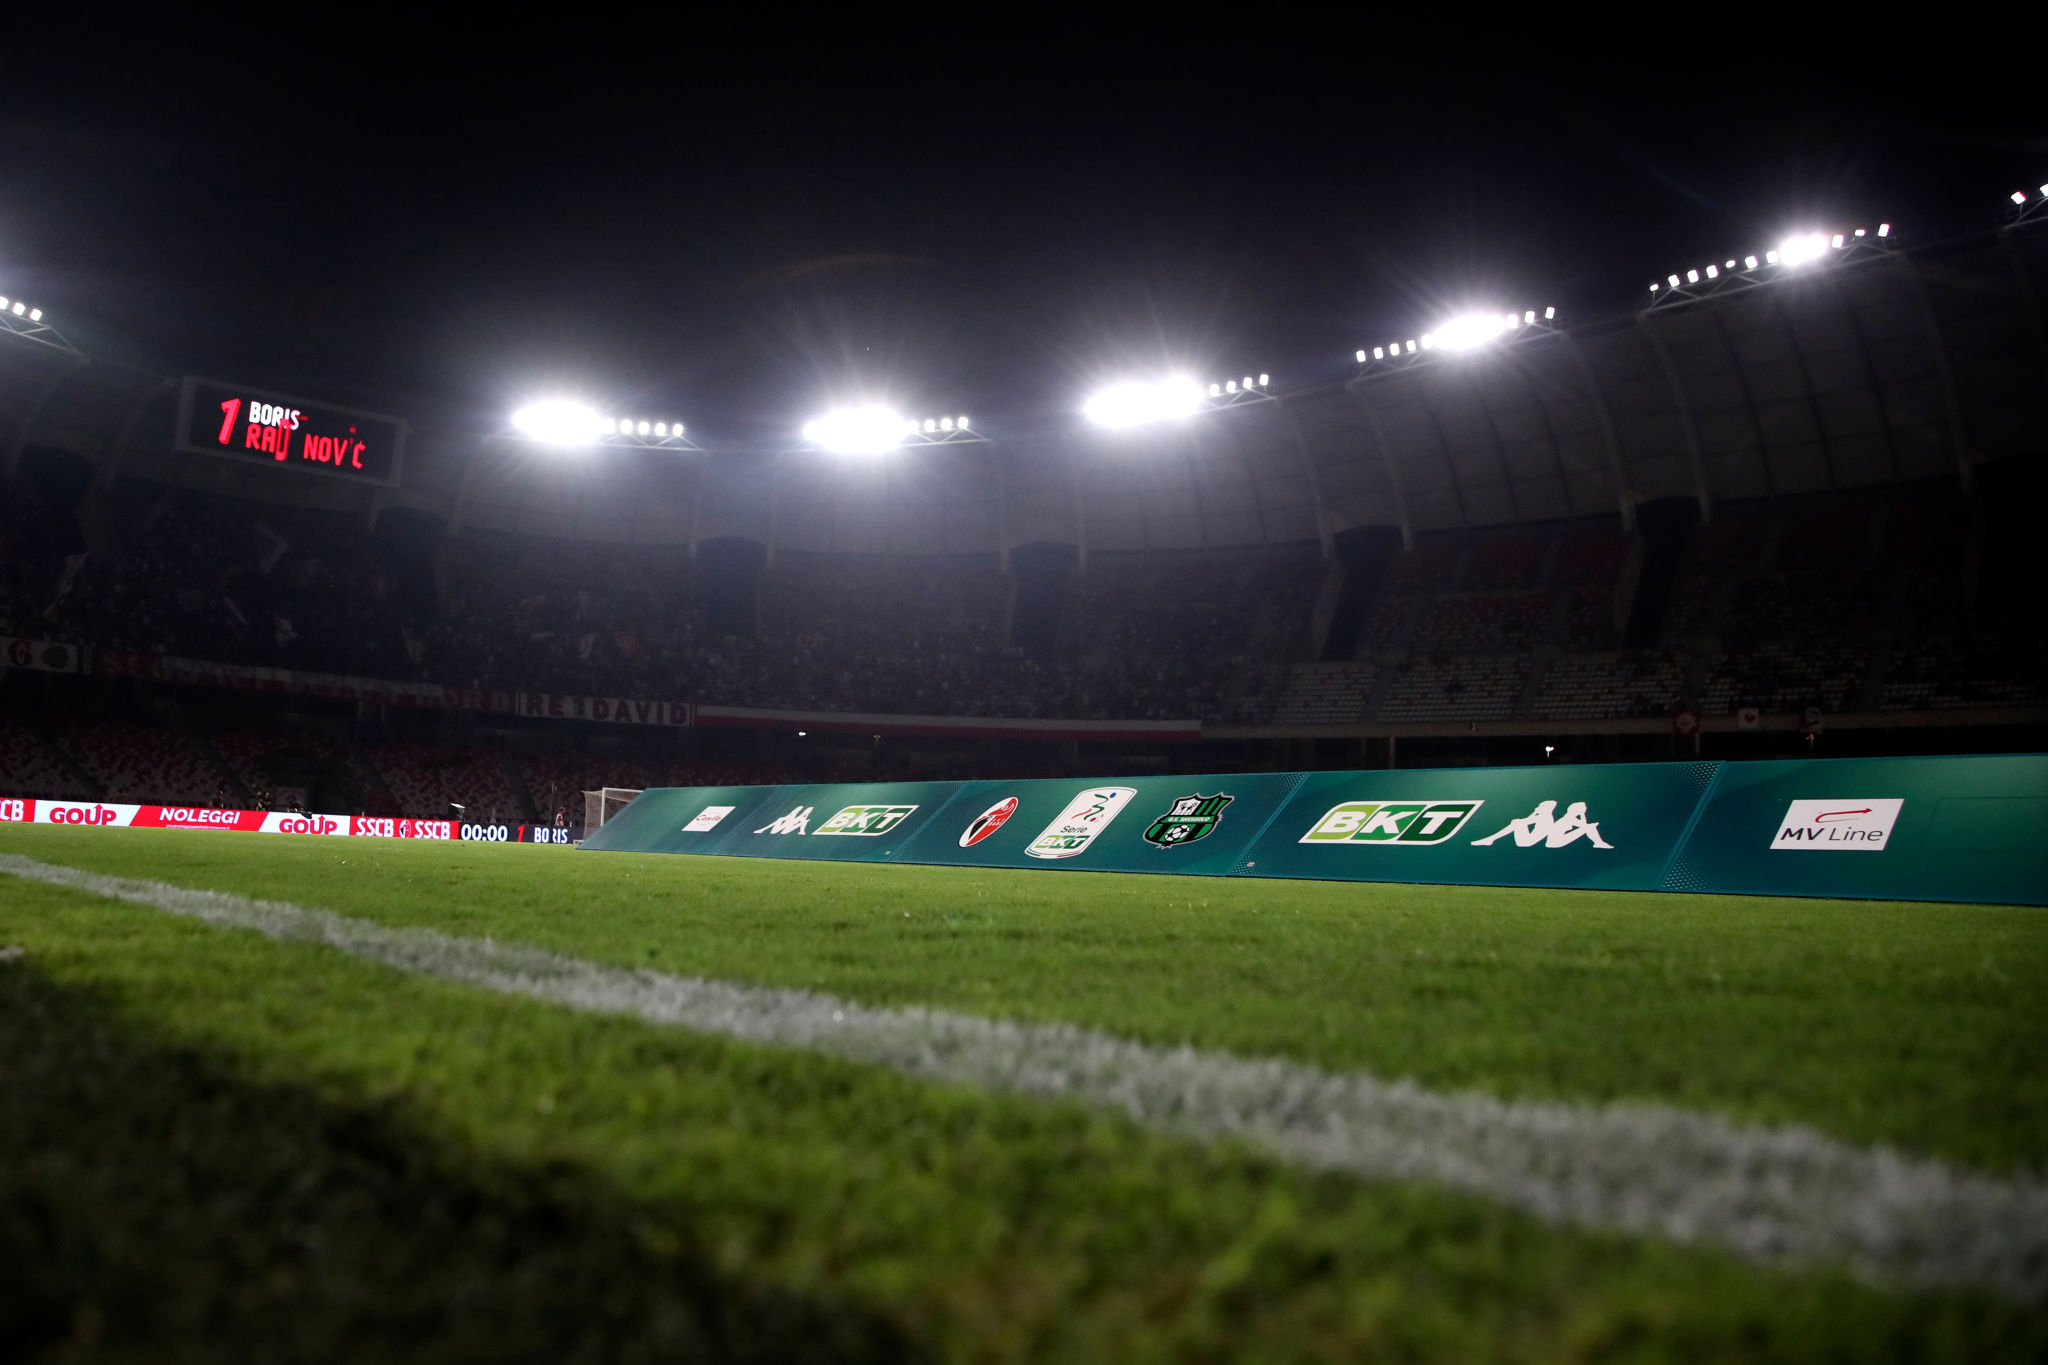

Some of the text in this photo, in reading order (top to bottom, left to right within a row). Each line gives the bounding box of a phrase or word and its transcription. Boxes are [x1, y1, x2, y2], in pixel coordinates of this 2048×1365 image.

[218, 398, 241, 445] 1
[249, 401, 301, 430] BORIS
[592, 699, 688, 726] DAVID
[0, 797, 24, 821] CB
[49, 804, 117, 826] GOUP
[159, 807, 240, 825] NOLEGGI
[279, 815, 337, 834] GOUP
[356, 817, 450, 840] SSCB SSCB
[461, 824, 508, 842] 00:00
[517, 824, 526, 842] 1
[1060, 825, 1089, 834] Serie
[1317, 811, 1465, 835] BKT
[1036, 835, 1090, 849] BKT
[1781, 826, 1883, 841] MV Line
